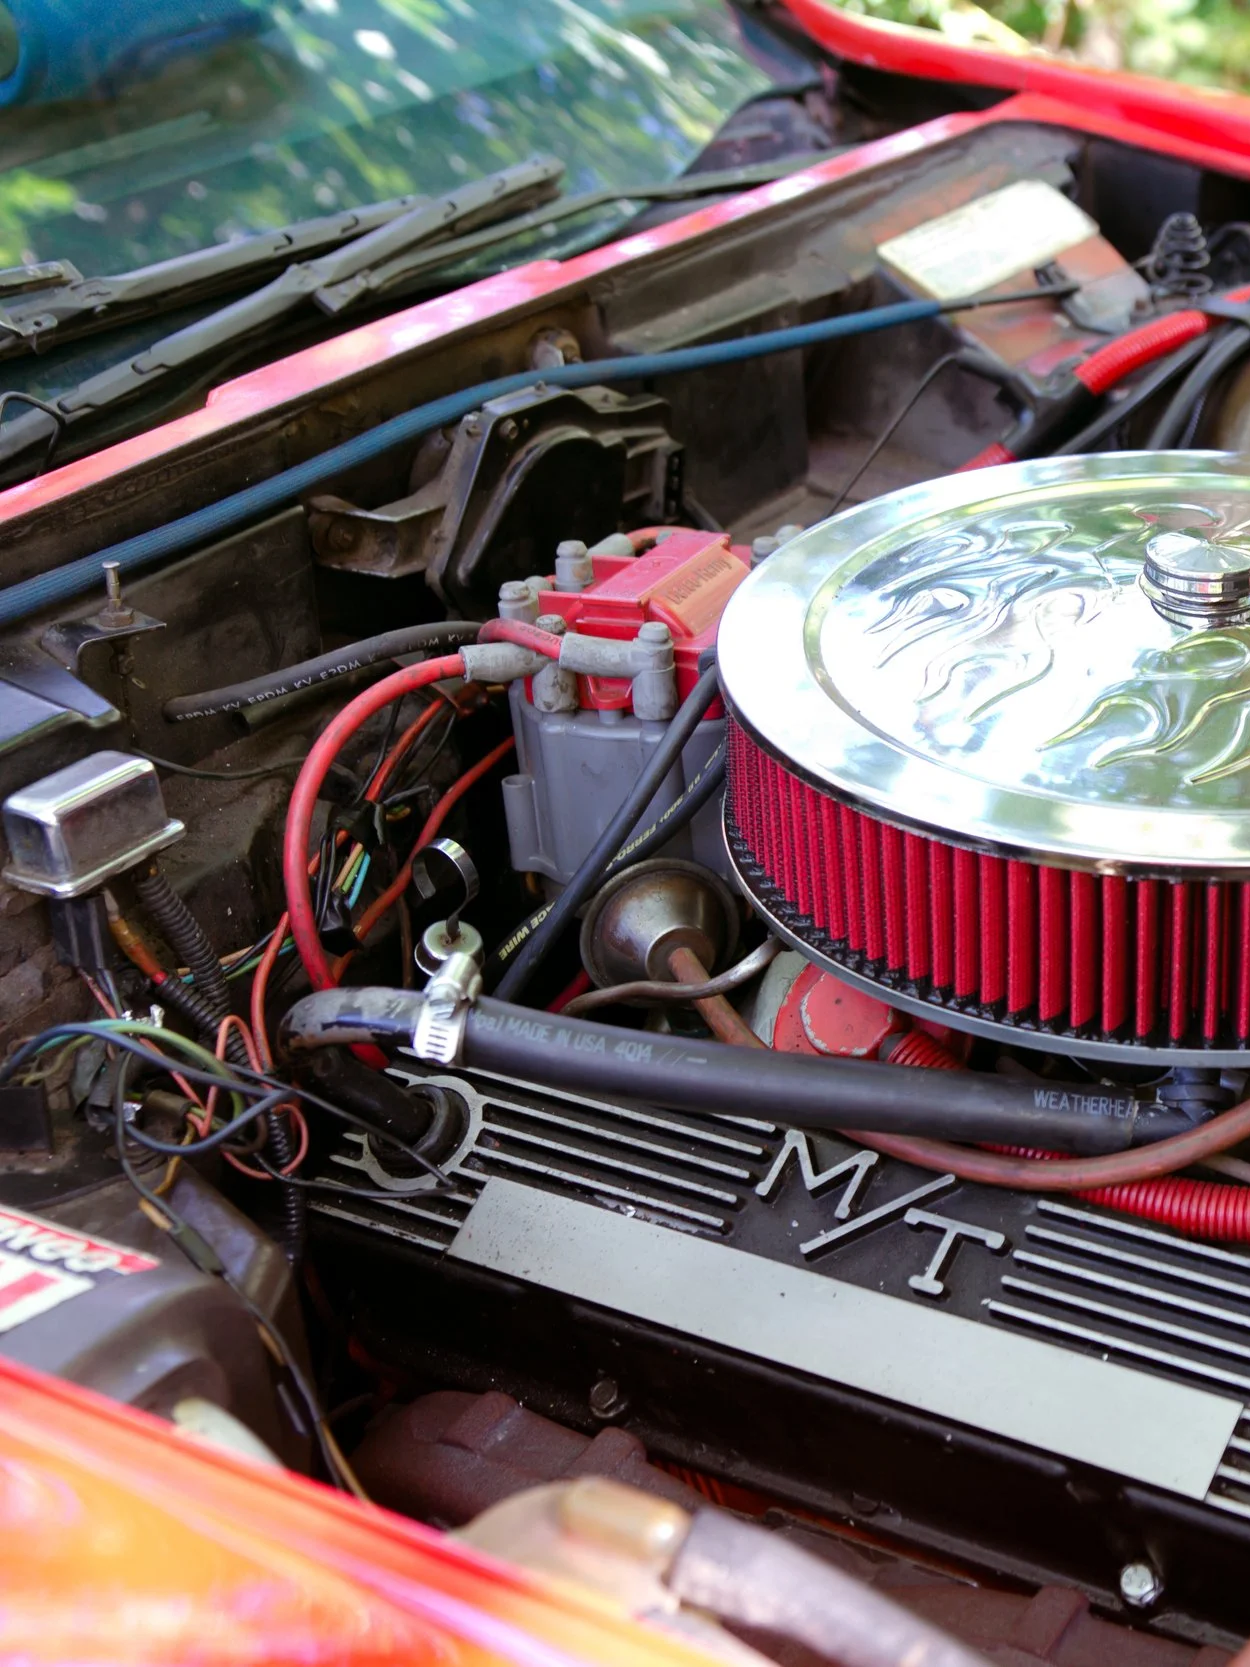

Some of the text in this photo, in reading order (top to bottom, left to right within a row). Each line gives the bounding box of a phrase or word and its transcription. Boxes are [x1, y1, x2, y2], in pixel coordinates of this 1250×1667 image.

[499, 925, 530, 961] WIRE
[507, 1015, 553, 1042] MADE
[554, 1029, 572, 1047] IN
[573, 1032, 606, 1054] USA
[755, 1129, 1005, 1295] M/T
